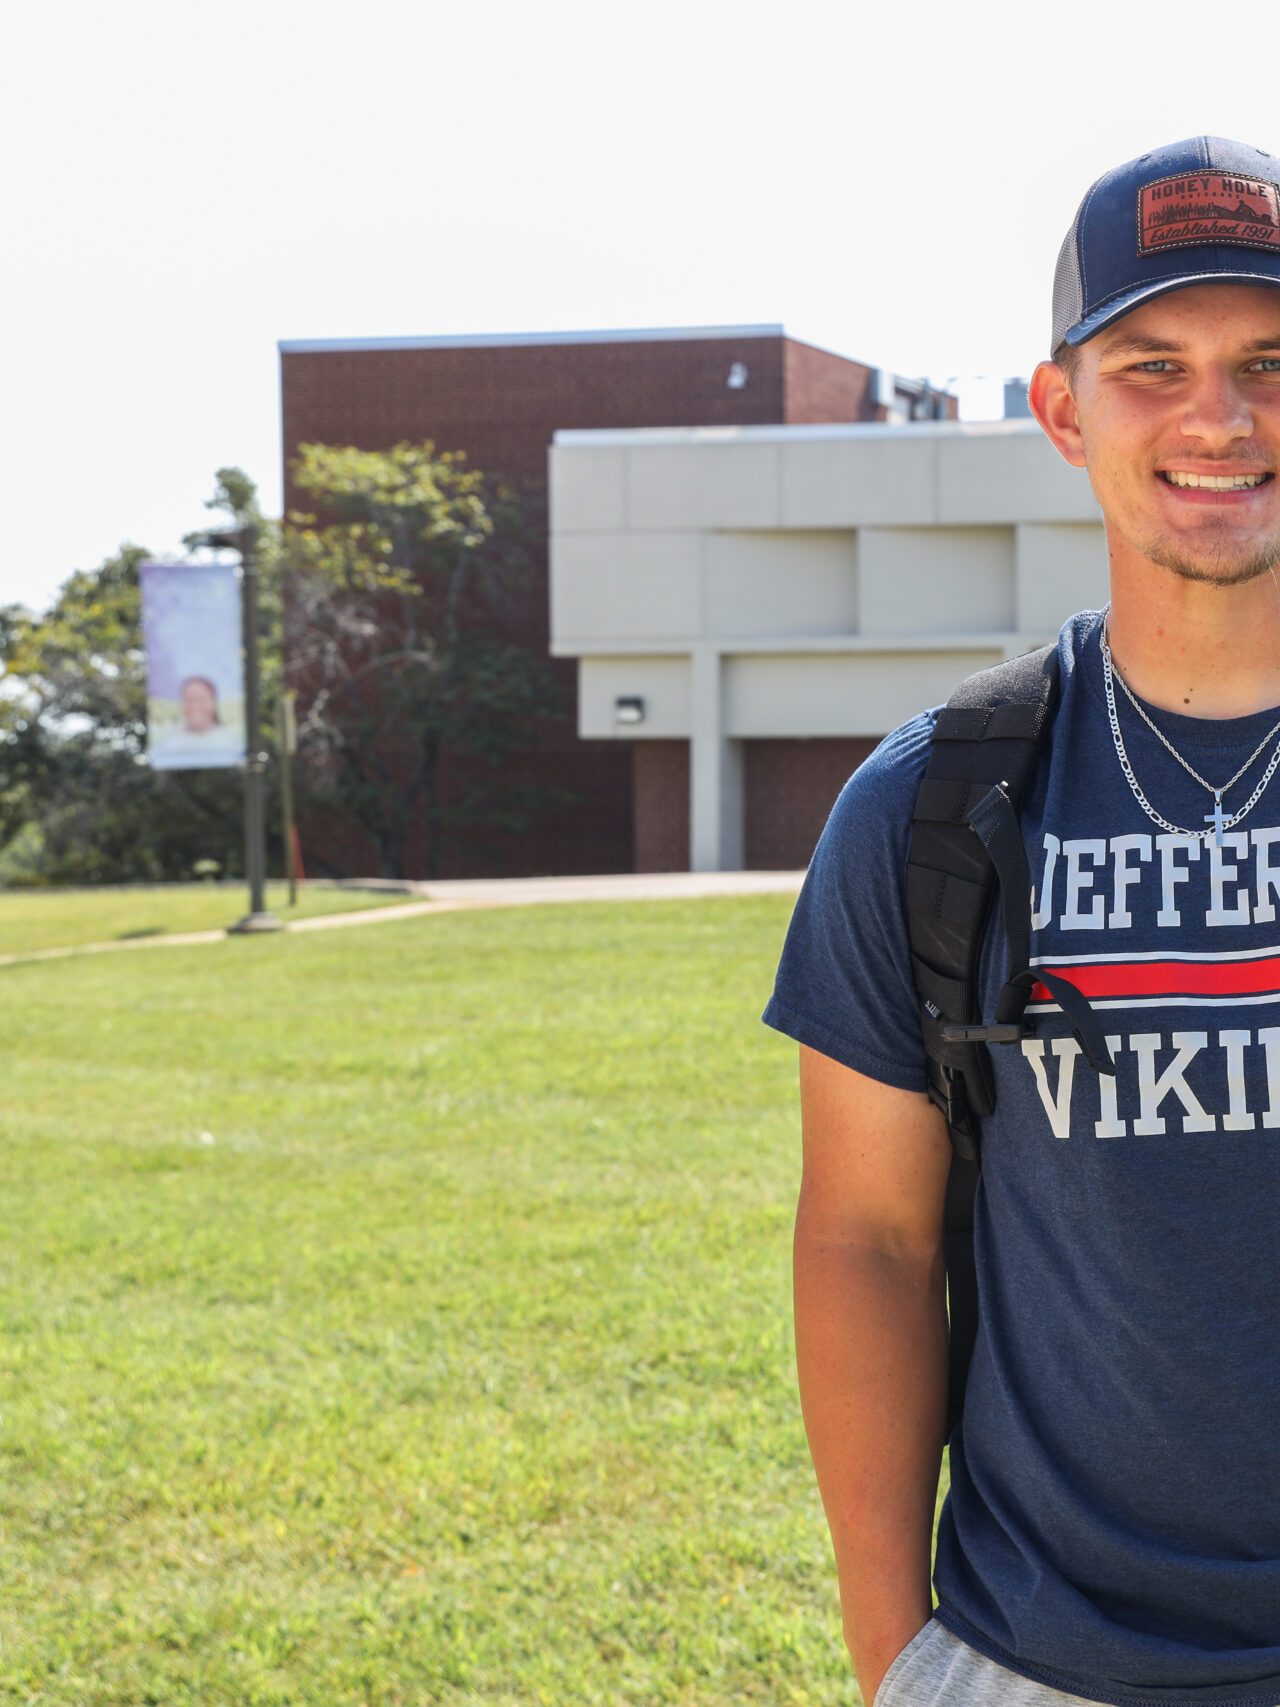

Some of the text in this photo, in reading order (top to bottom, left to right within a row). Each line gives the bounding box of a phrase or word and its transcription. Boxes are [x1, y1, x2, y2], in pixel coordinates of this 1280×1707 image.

[1151, 178, 1210, 201] HONEY
[1221, 178, 1268, 198] HOLE
[1150, 221, 1274, 243] Established 1991
